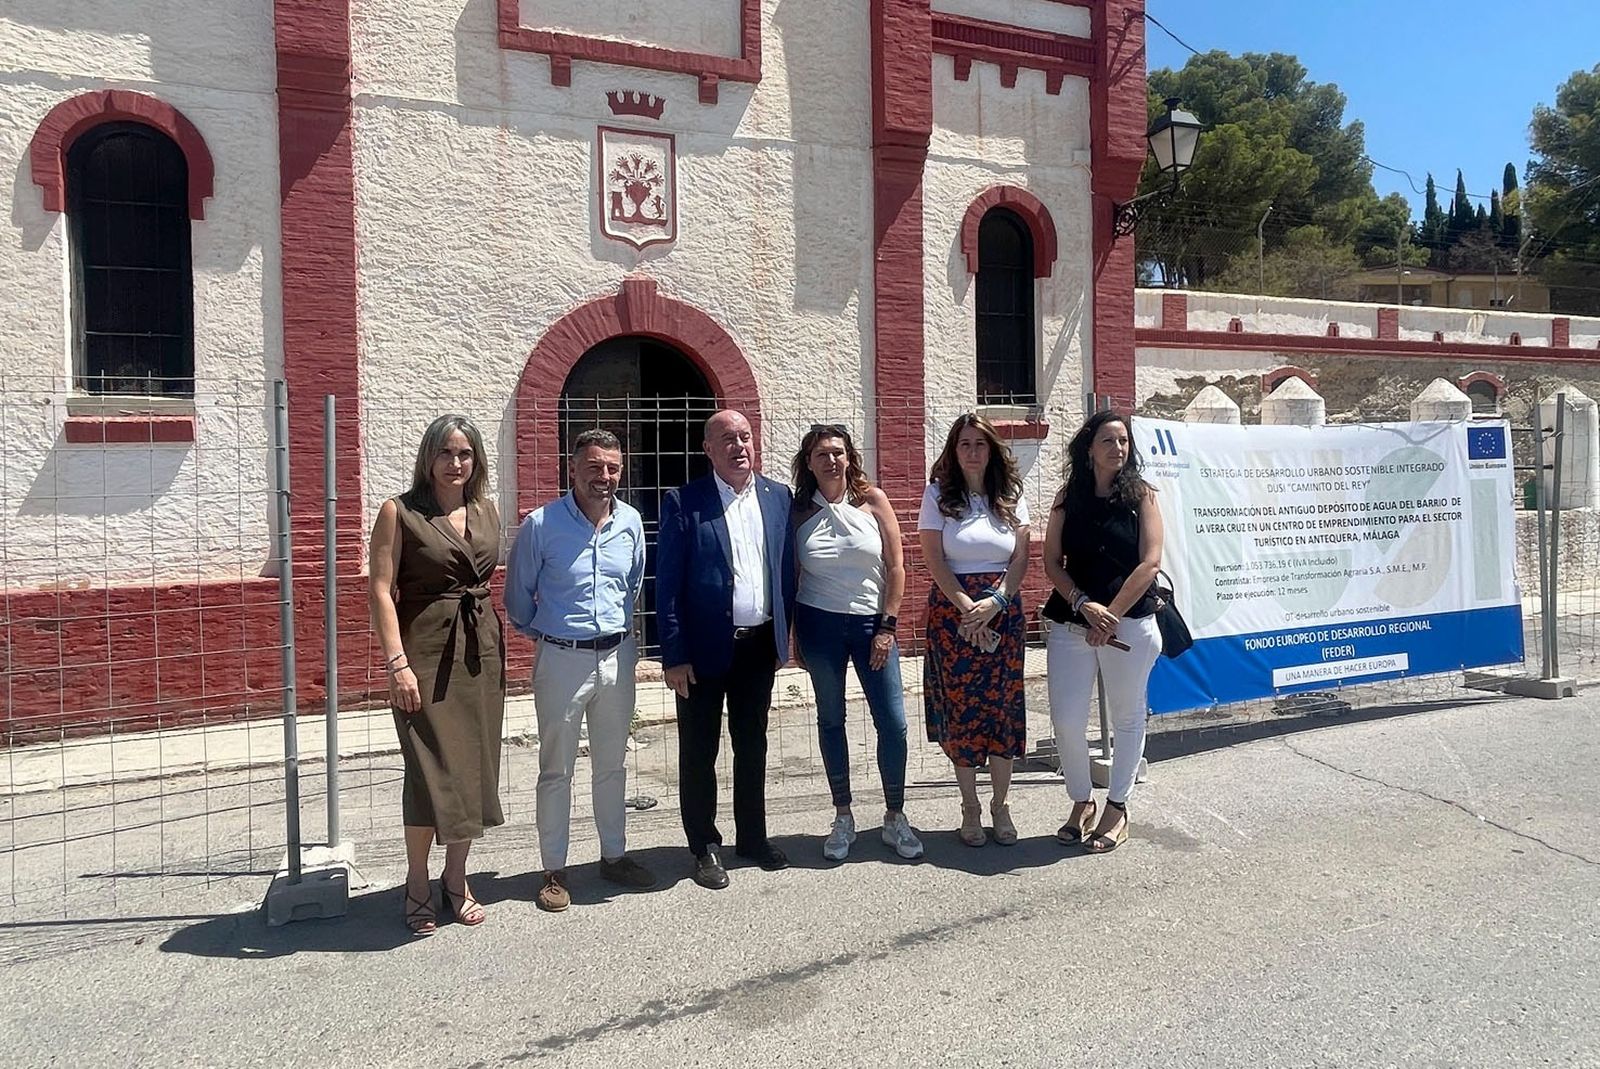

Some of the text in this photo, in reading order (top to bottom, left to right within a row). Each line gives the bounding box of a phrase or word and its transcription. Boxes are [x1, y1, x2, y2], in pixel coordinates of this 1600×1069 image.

[1200, 462, 1444, 478] ESTRATEGIA DE DESARROLLO URBANO SOSTENIBLE INTEGRADO
[1287, 482, 1332, 492] "CAMINITO
[1334, 481, 1350, 490] DEL
[1194, 497, 1461, 518] TRANSFORMACIÓN DEL ANTIGUO DEPÓSITO DE AGUA DEL BARRIO DE
[1196, 511, 1462, 534] LA VERA CRUZ EN UN CENTRO DE EMPRENDIMIENTO PARA EL SECTOR
[1254, 530, 1400, 547] TURÍSTICO EN ANTEQUERA, MÁLAGA
[1293, 559, 1307, 568] (IVA
[1308, 556, 1338, 566] Incluido)
[1214, 577, 1251, 587] Contratista:
[1253, 575, 1279, 584] Empresa
[1291, 570, 1341, 581] Transformación
[1344, 569, 1368, 578] Agraria
[1216, 592, 1234, 600] Plazo
[1235, 591, 1243, 599] de
[1278, 587, 1285, 595] 12
[1330, 608, 1354, 617] urbano
[1355, 604, 1390, 614] sostenible
[1245, 620, 1432, 651] FONDO EUROPEO DE DESARROLLO REGIONAL
[1322, 645, 1355, 661] (FEDER)
[1285, 660, 1397, 682] UNA MANERA DE HACER EUROPA
